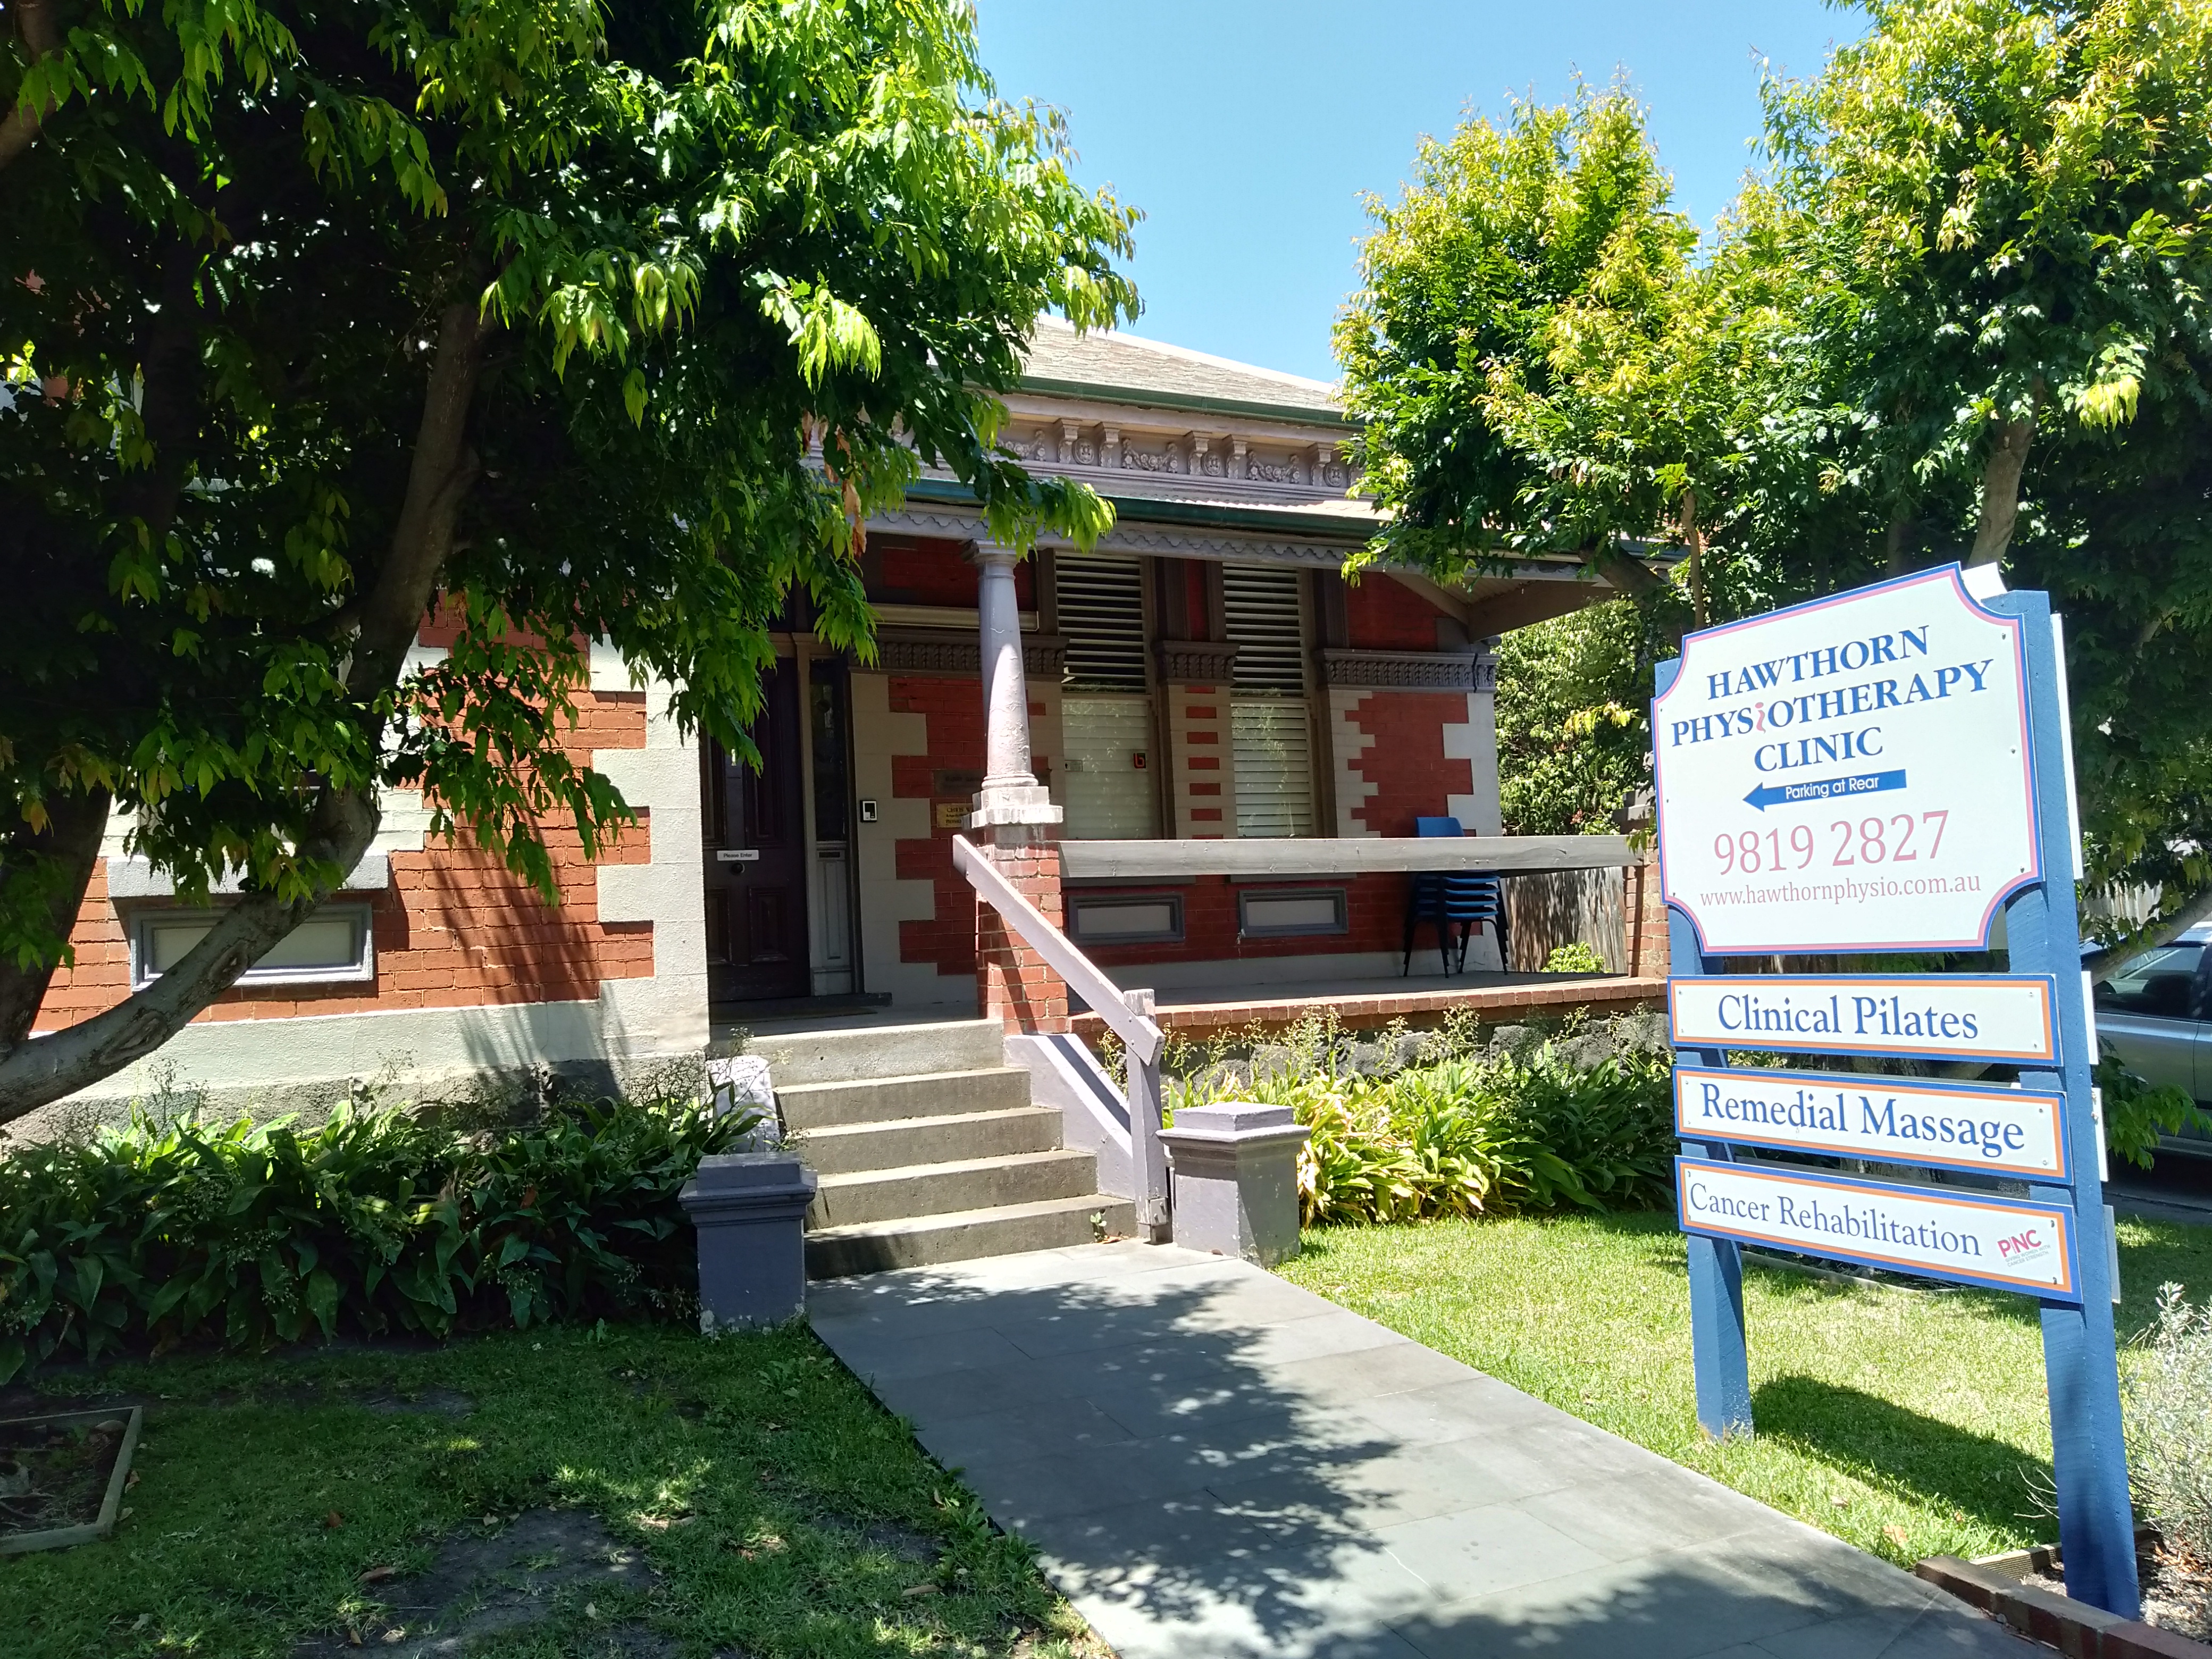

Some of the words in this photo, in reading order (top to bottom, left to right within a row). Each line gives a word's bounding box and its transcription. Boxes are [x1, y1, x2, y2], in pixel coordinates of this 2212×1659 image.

[1707, 625, 1929, 700] HAWTHORN
[1755, 727, 1882, 771] CLINIC
[1786, 783, 1829, 800] Parking
[1832, 779, 1845, 793] at
[1849, 777, 1879, 791] Rear
[1715, 825, 1813, 875] 9819
[1831, 810, 1949, 866] 2827
[1700, 876, 1981, 906] www.hawthornphysio.com.au
[1719, 994, 1842, 1033] Clinical
[1851, 995, 1978, 1038] Pilates
[1700, 1083, 1848, 1132] Remedial
[1858, 1096, 2025, 1158] Massage
[1690, 1183, 1770, 1222] Cancer
[1777, 1196, 1982, 1256] Rehabilitation
[2007, 1258, 2025, 1267] CANCER
[2025, 1251, 2049, 1261] STRENGTH
[2021, 1249, 2039, 1258] WOMEN
